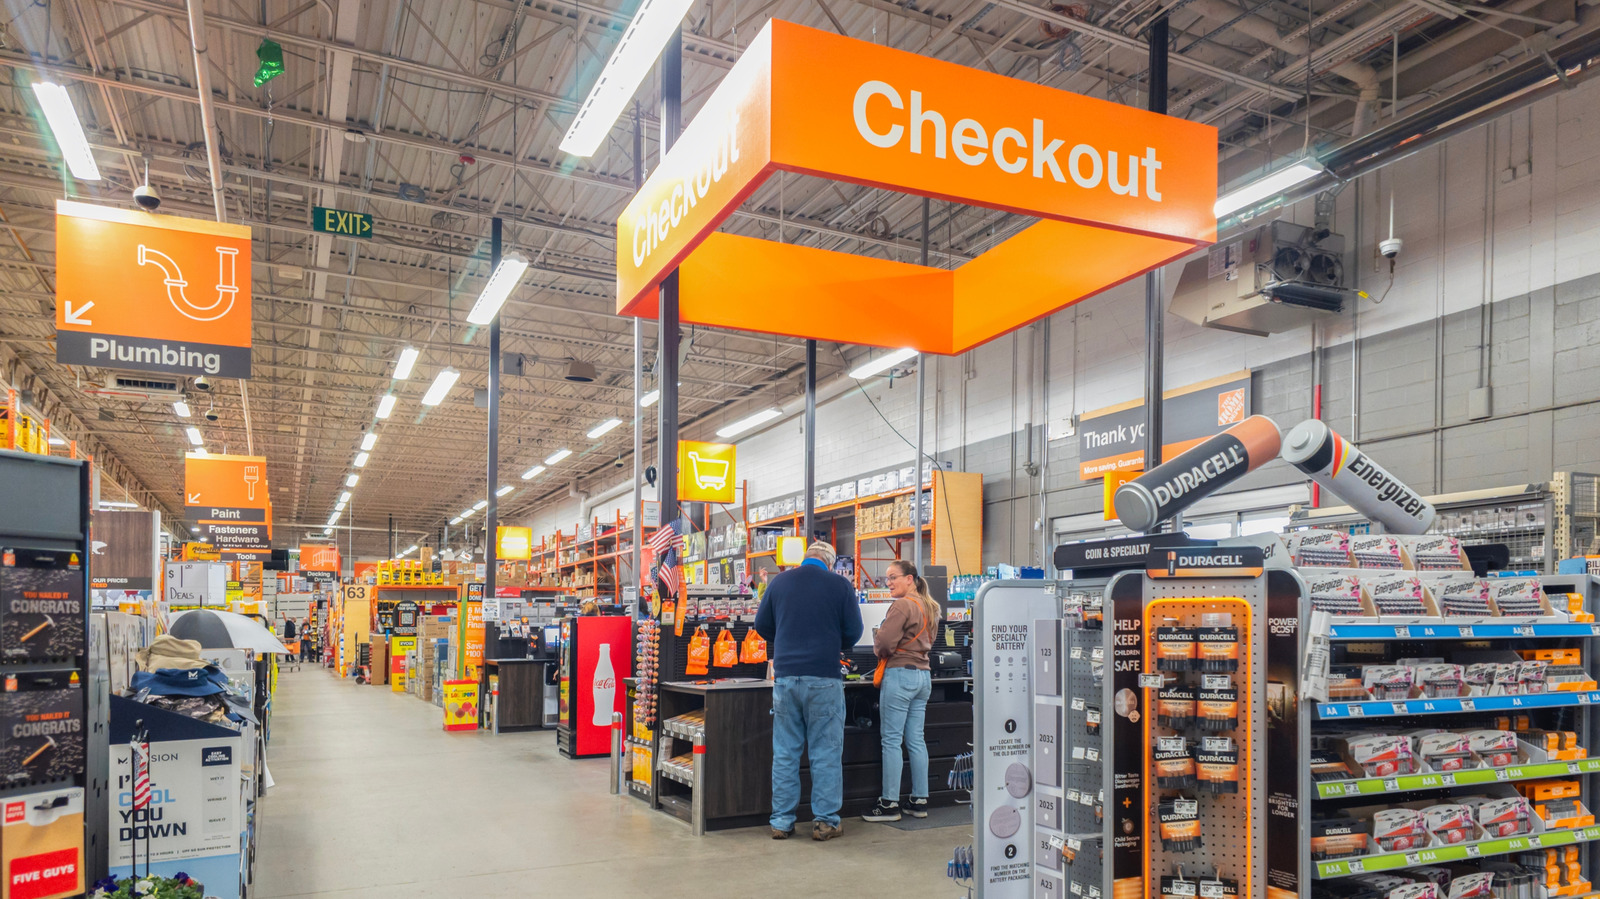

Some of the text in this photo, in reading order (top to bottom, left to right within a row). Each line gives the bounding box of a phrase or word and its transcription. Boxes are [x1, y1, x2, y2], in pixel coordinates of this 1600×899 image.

[852, 79, 1163, 203] Checkout
[633, 107, 740, 268] Checkout
[325, 210, 363, 235] EXIT
[90, 337, 221, 373] Plumbing
[1084, 425, 1127, 449] Thank
[1084, 465, 1099, 475] More
[1099, 462, 1117, 474] saving.
[1153, 446, 1244, 508] DURACELL
[1347, 452, 1427, 518] Energizer
[211, 508, 241, 519] Paint
[208, 525, 258, 535] Fasteners
[216, 535, 260, 544] Hardware
[1300, 533, 1332, 547] Energizer
[1353, 538, 1382, 551] Energizer
[1416, 538, 1444, 552] Energizer
[1085, 543, 1150, 560] COIN & SPECIALTY
[1179, 555, 1241, 566] DURACELL
[168, 570, 175, 579] $
[1311, 578, 1343, 594] Energizer
[1374, 579, 1405, 596] Energizer
[1444, 581, 1475, 595] Energizer
[1498, 582, 1526, 597] Energizer
[347, 586, 365, 599] 63
[11, 600, 80, 614] CONGRATS
[467, 621, 485, 629] Finan
[1114, 619, 1141, 631] HELP
[1268, 618, 1298, 626] POWER
[991, 625, 1028, 633] FIND YOUR
[1270, 625, 1295, 634] BOOST
[1424, 628, 1435, 636] AA
[992, 633, 1027, 642] SPECIALTY
[1114, 634, 1140, 646] KEEP
[996, 642, 1025, 650] BATTERY
[466, 650, 481, 658] $100
[1041, 648, 1051, 657] 123
[1114, 660, 1140, 672] SAFE
[1160, 691, 1193, 699] DURACELL
[1424, 702, 1435, 711] AA
[1513, 698, 1522, 706] AA
[41, 712, 64, 721] NAILED
[64, 711, 70, 719] IT
[1326, 707, 1338, 715] AA
[13, 719, 81, 738] CONGRATS
[1039, 734, 1054, 743] 2032
[1155, 751, 1190, 760] DURACELL
[1199, 755, 1235, 763] DURACELL
[1510, 769, 1523, 777] AAA
[1422, 777, 1437, 786] AAA
[1326, 786, 1342, 794] AAA
[119, 789, 176, 807] COL
[1268, 798, 1298, 808] BRIGHTEST
[1039, 800, 1054, 810] 2025
[119, 807, 163, 824] YOU
[1161, 813, 1197, 821] DURACELL
[1272, 809, 1295, 819] LONGER
[119, 822, 187, 842] DOWN
[1588, 829, 1600, 837] AAA
[1509, 840, 1523, 849] AAA
[1008, 847, 1013, 856] 2
[1422, 852, 1437, 861] AAA
[13, 864, 75, 885] FIVE GUYS
[1326, 865, 1342, 874] AAA
[1041, 878, 1053, 890] A23
